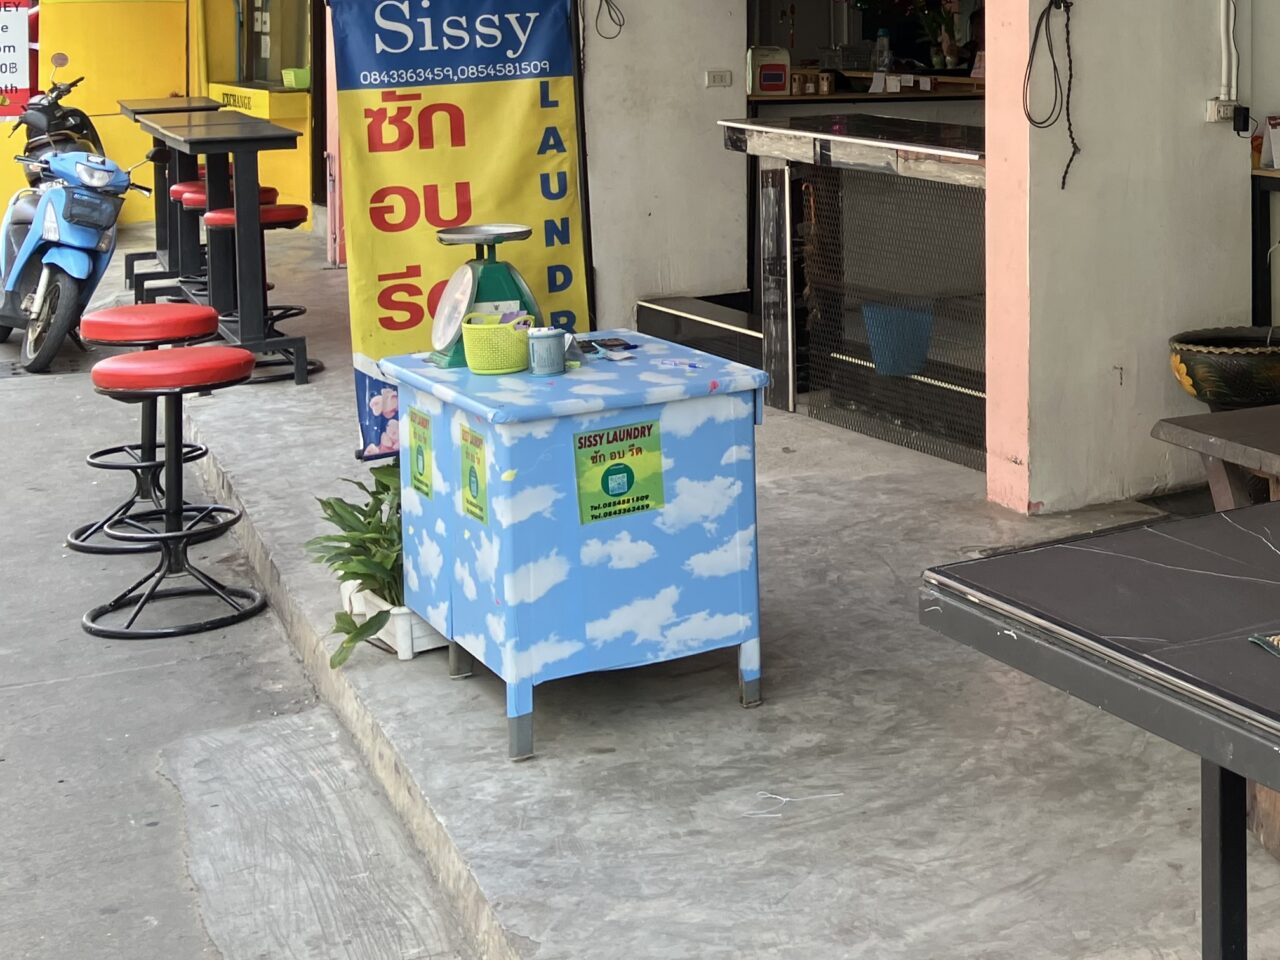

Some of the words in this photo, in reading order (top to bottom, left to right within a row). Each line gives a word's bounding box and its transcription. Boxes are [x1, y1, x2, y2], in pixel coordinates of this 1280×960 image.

[0, 2, 22, 12] EY
[374, 0, 540, 59] Sissy
[222, 92, 252, 110] EXCHANGE
[364, 90, 466, 153] ซัก
[369, 181, 472, 233] อบ
[577, 432, 606, 450] SISSY
[605, 423, 654, 445] LAUNDRY
